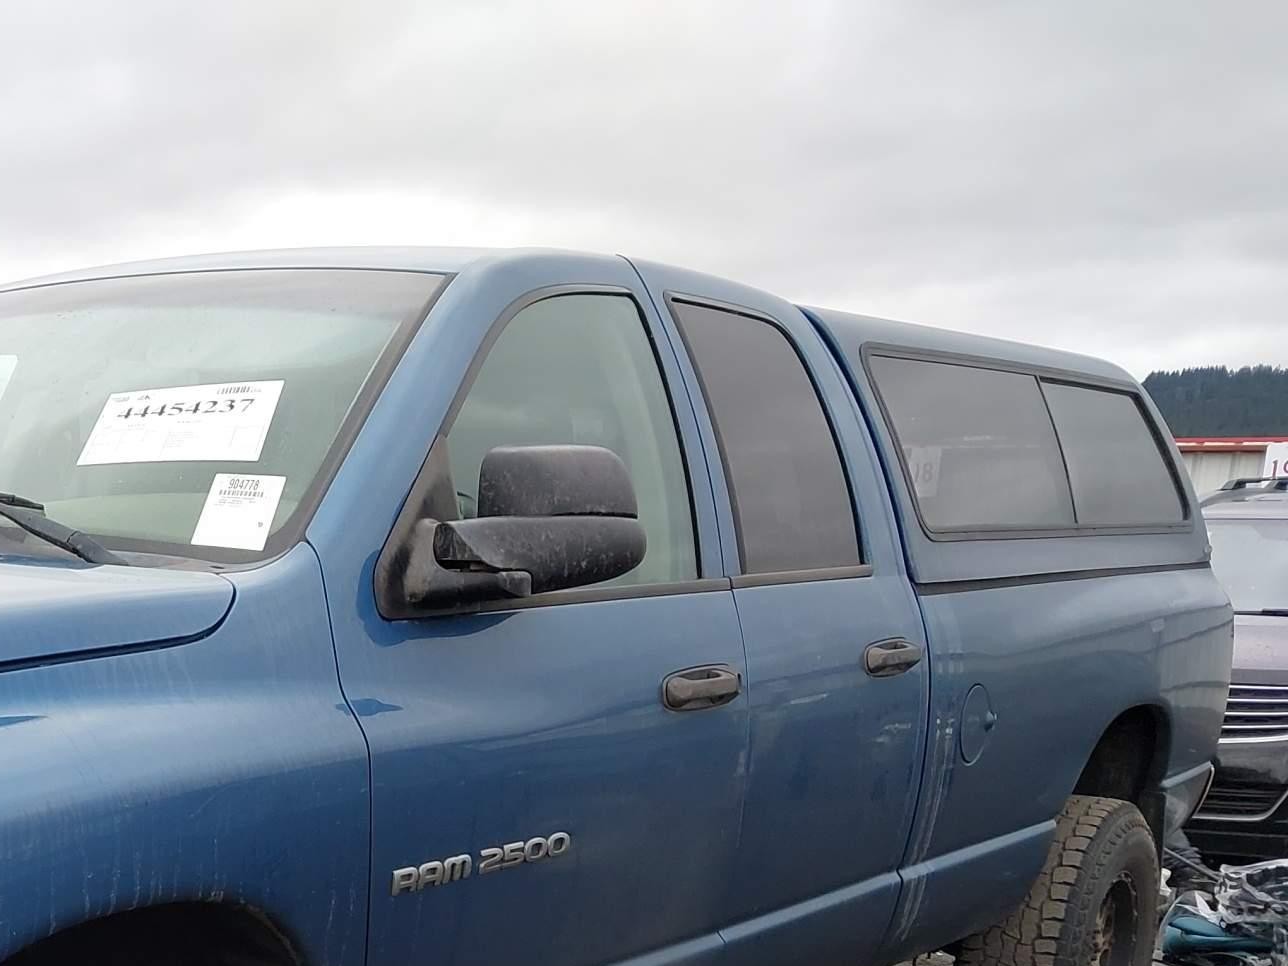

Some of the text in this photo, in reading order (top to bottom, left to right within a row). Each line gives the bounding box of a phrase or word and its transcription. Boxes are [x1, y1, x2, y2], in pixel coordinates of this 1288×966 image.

[117, 398, 255, 419] 44454237
[228, 478, 260, 491] 904778
[391, 831, 571, 897] RAM 2500
